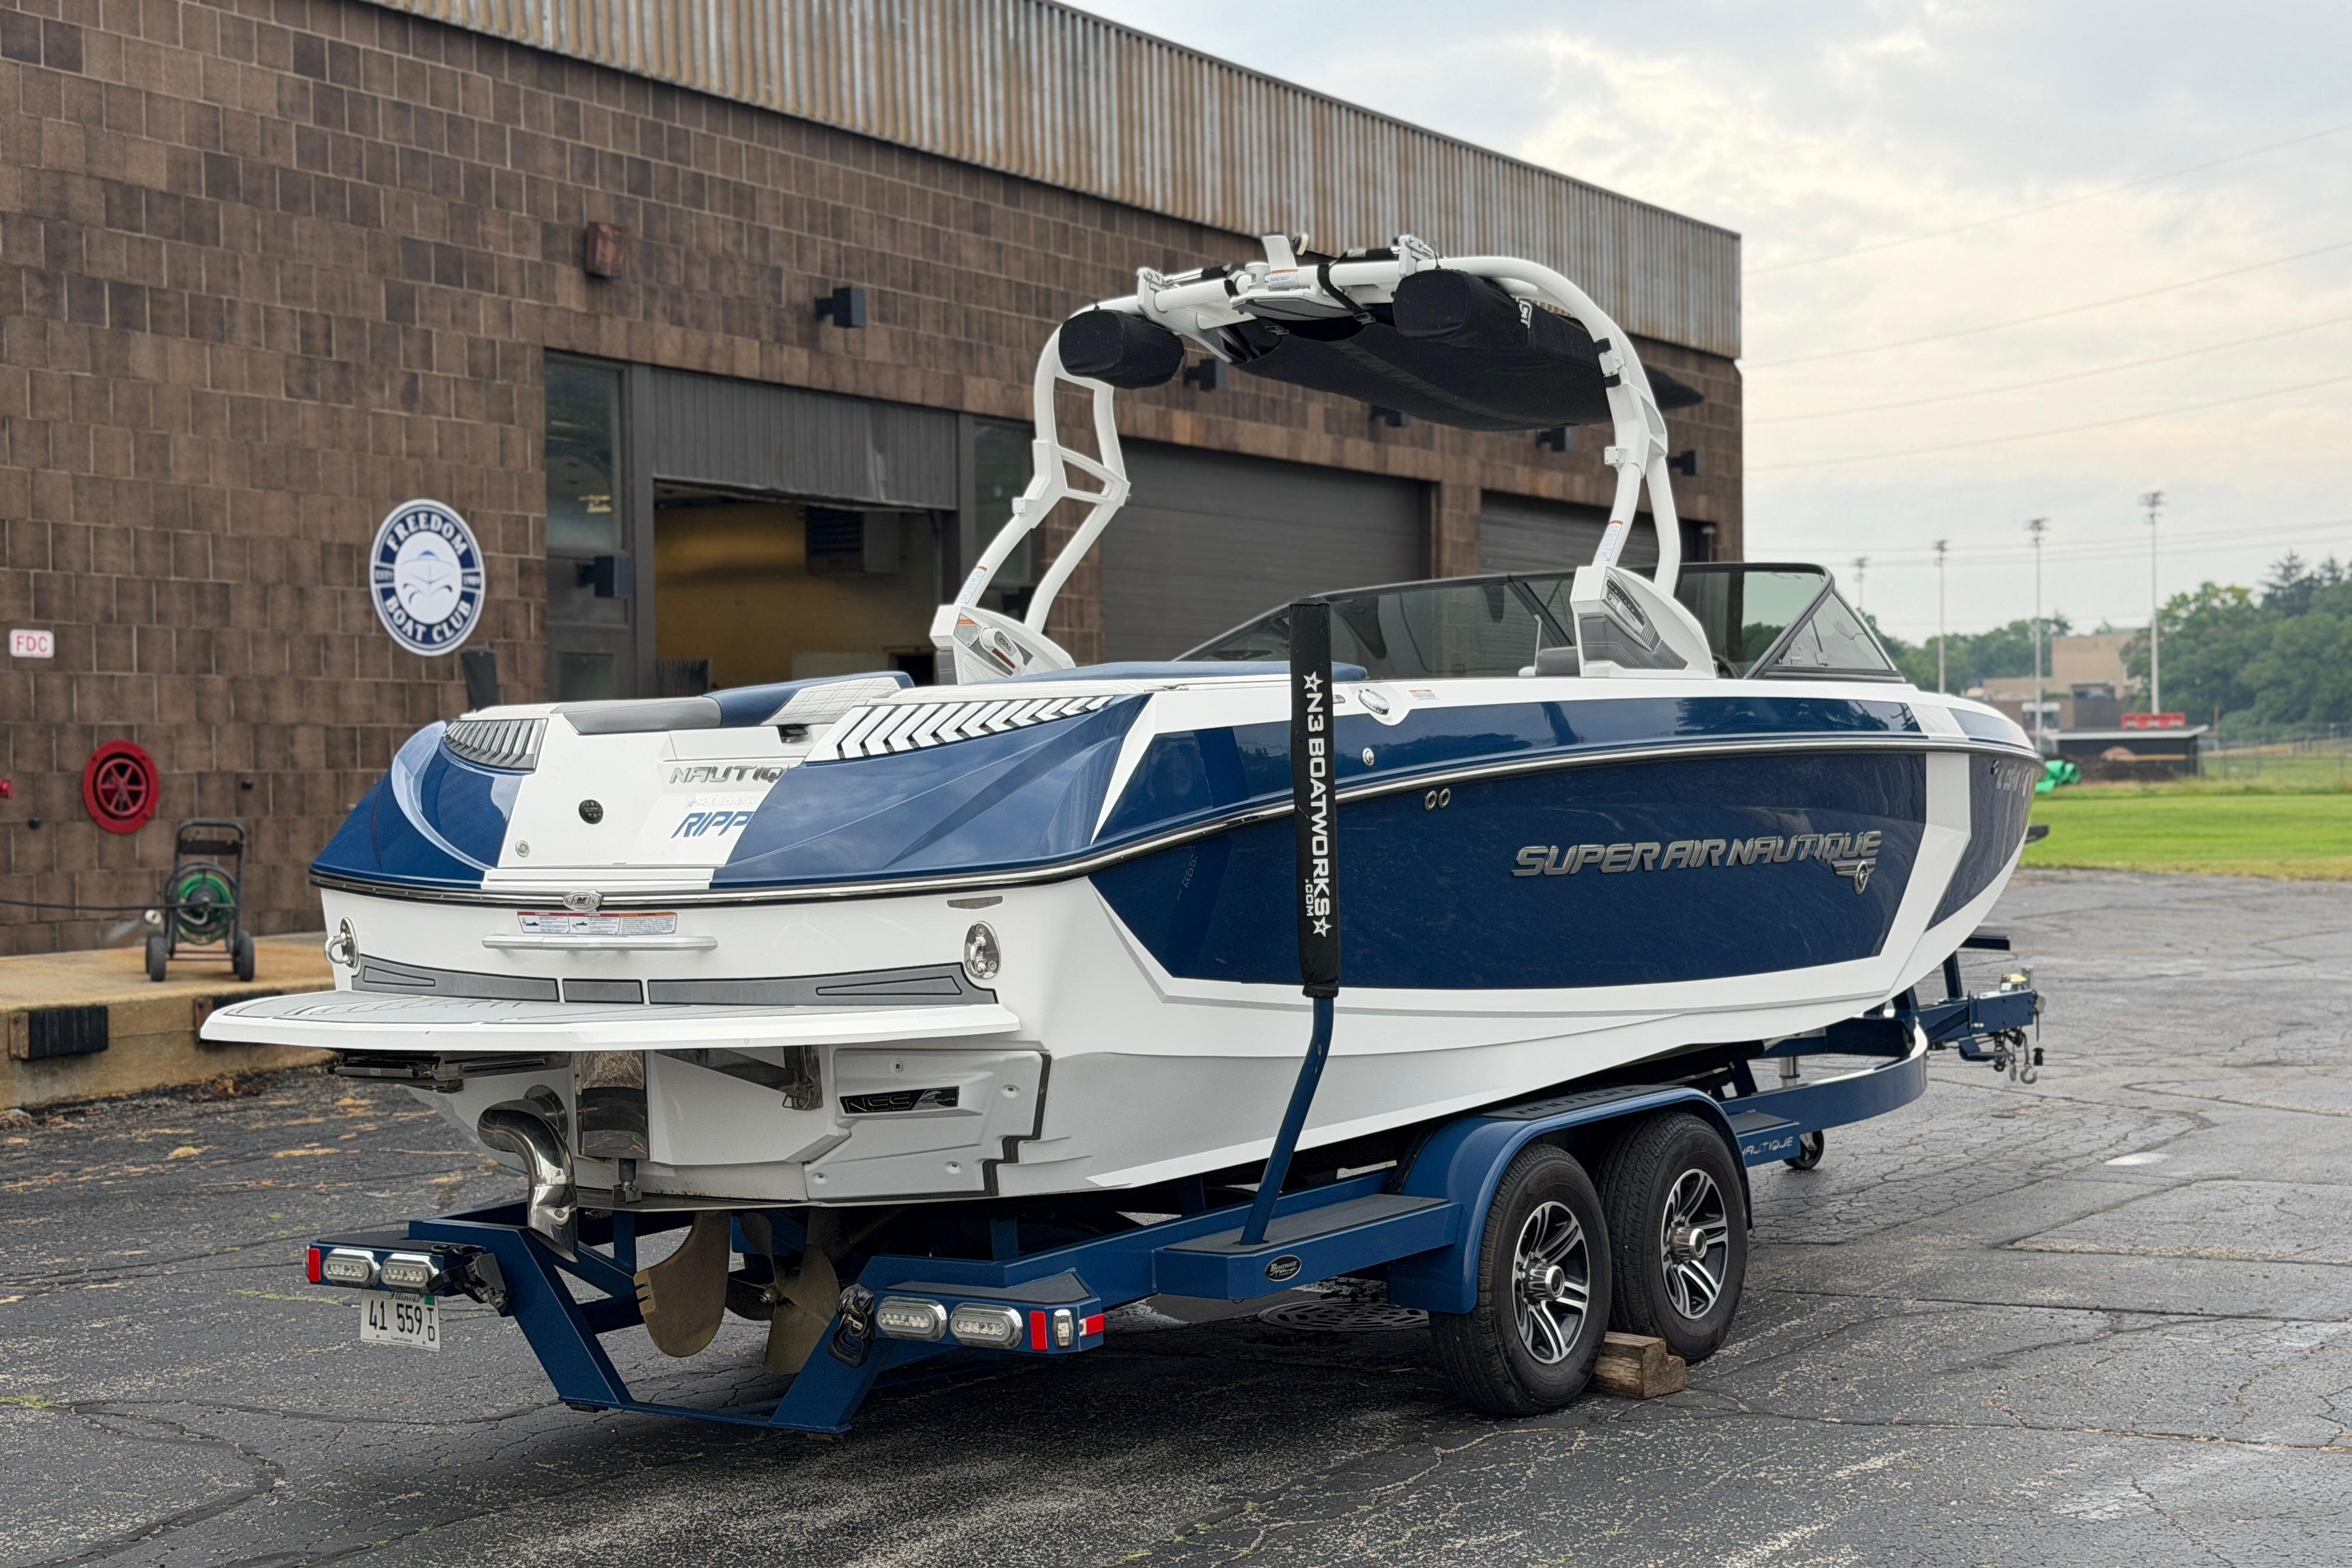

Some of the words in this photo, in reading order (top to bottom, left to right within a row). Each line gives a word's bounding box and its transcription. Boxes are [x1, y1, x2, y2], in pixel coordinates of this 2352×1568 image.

[386, 513, 468, 556] FREEDOM
[385, 596, 426, 641] BOAT
[432, 600, 471, 642] CLUB
[16, 635, 47, 652] FDC
[1307, 692, 1324, 732] N3
[1308, 738, 1330, 916] BOATWORKS
[1511, 842, 1661, 876] SUPER
[1661, 839, 1726, 870] AIR
[1726, 831, 1882, 867] NAUTIQUE
[1305, 878, 1314, 916] .COM
[369, 1300, 388, 1331] 41
[397, 1303, 422, 1335] 559
